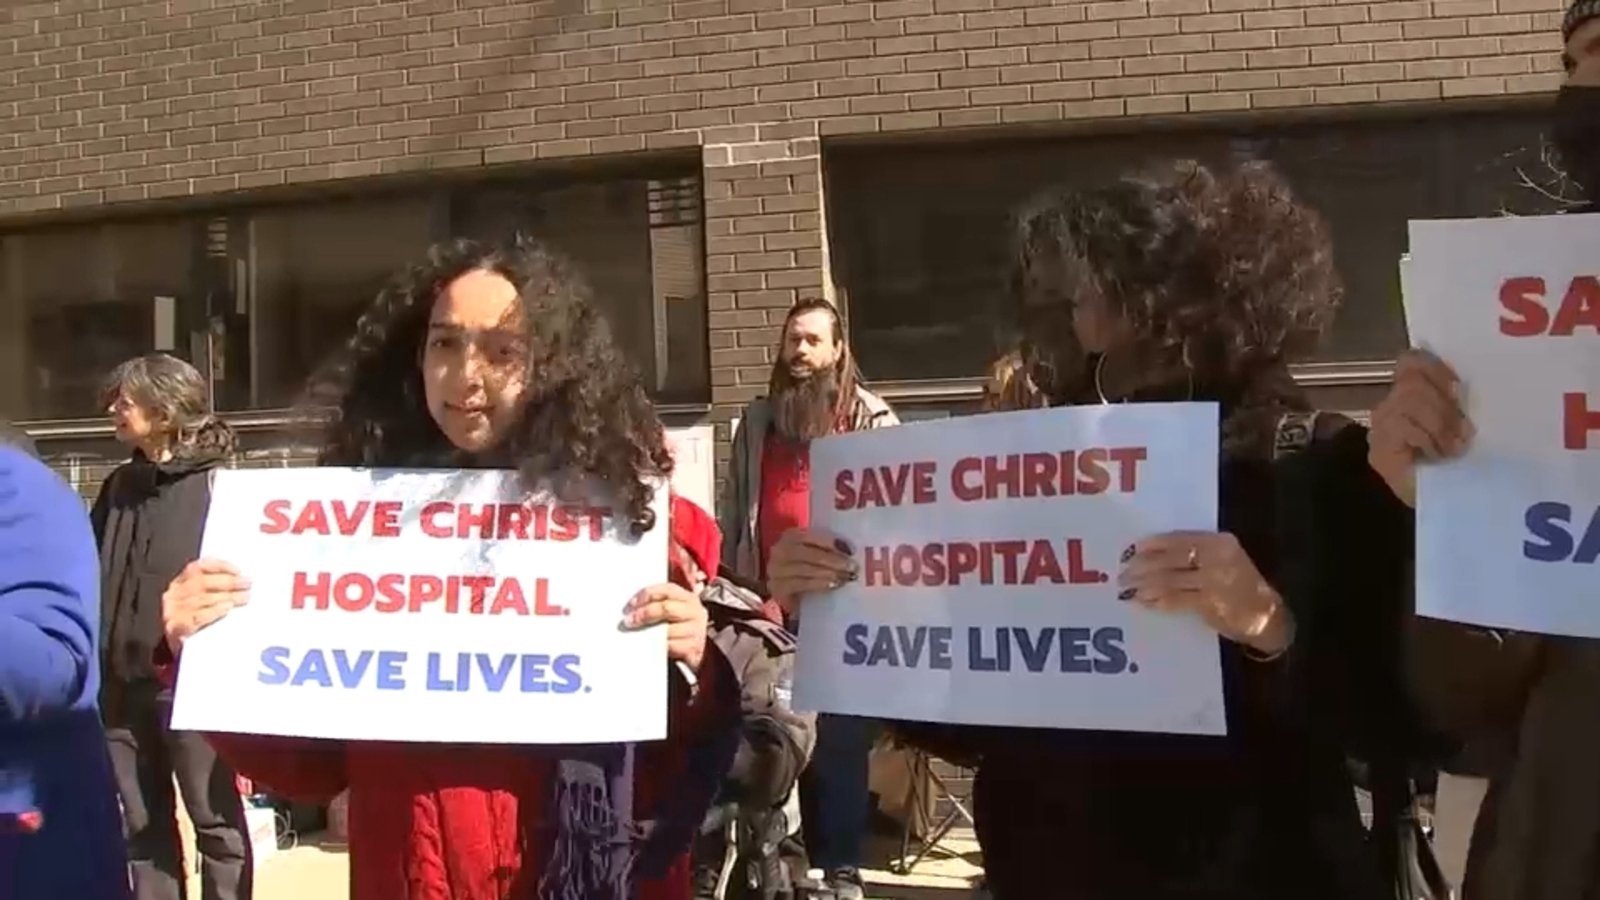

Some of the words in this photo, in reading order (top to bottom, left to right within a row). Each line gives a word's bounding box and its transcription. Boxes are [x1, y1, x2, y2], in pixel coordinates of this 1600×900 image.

[834, 461, 937, 510] SAVE
[951, 447, 1147, 500] CHRIST
[260, 499, 401, 537] SAVE
[420, 501, 614, 541] CHRIST
[864, 538, 1108, 587] HOSPITAL.
[291, 571, 570, 616] HOSPITAL.
[257, 646, 407, 690] SAVE
[426, 652, 593, 694] LIVES.
[842, 623, 952, 670] SAVE
[967, 626, 1140, 674] LIVES.
